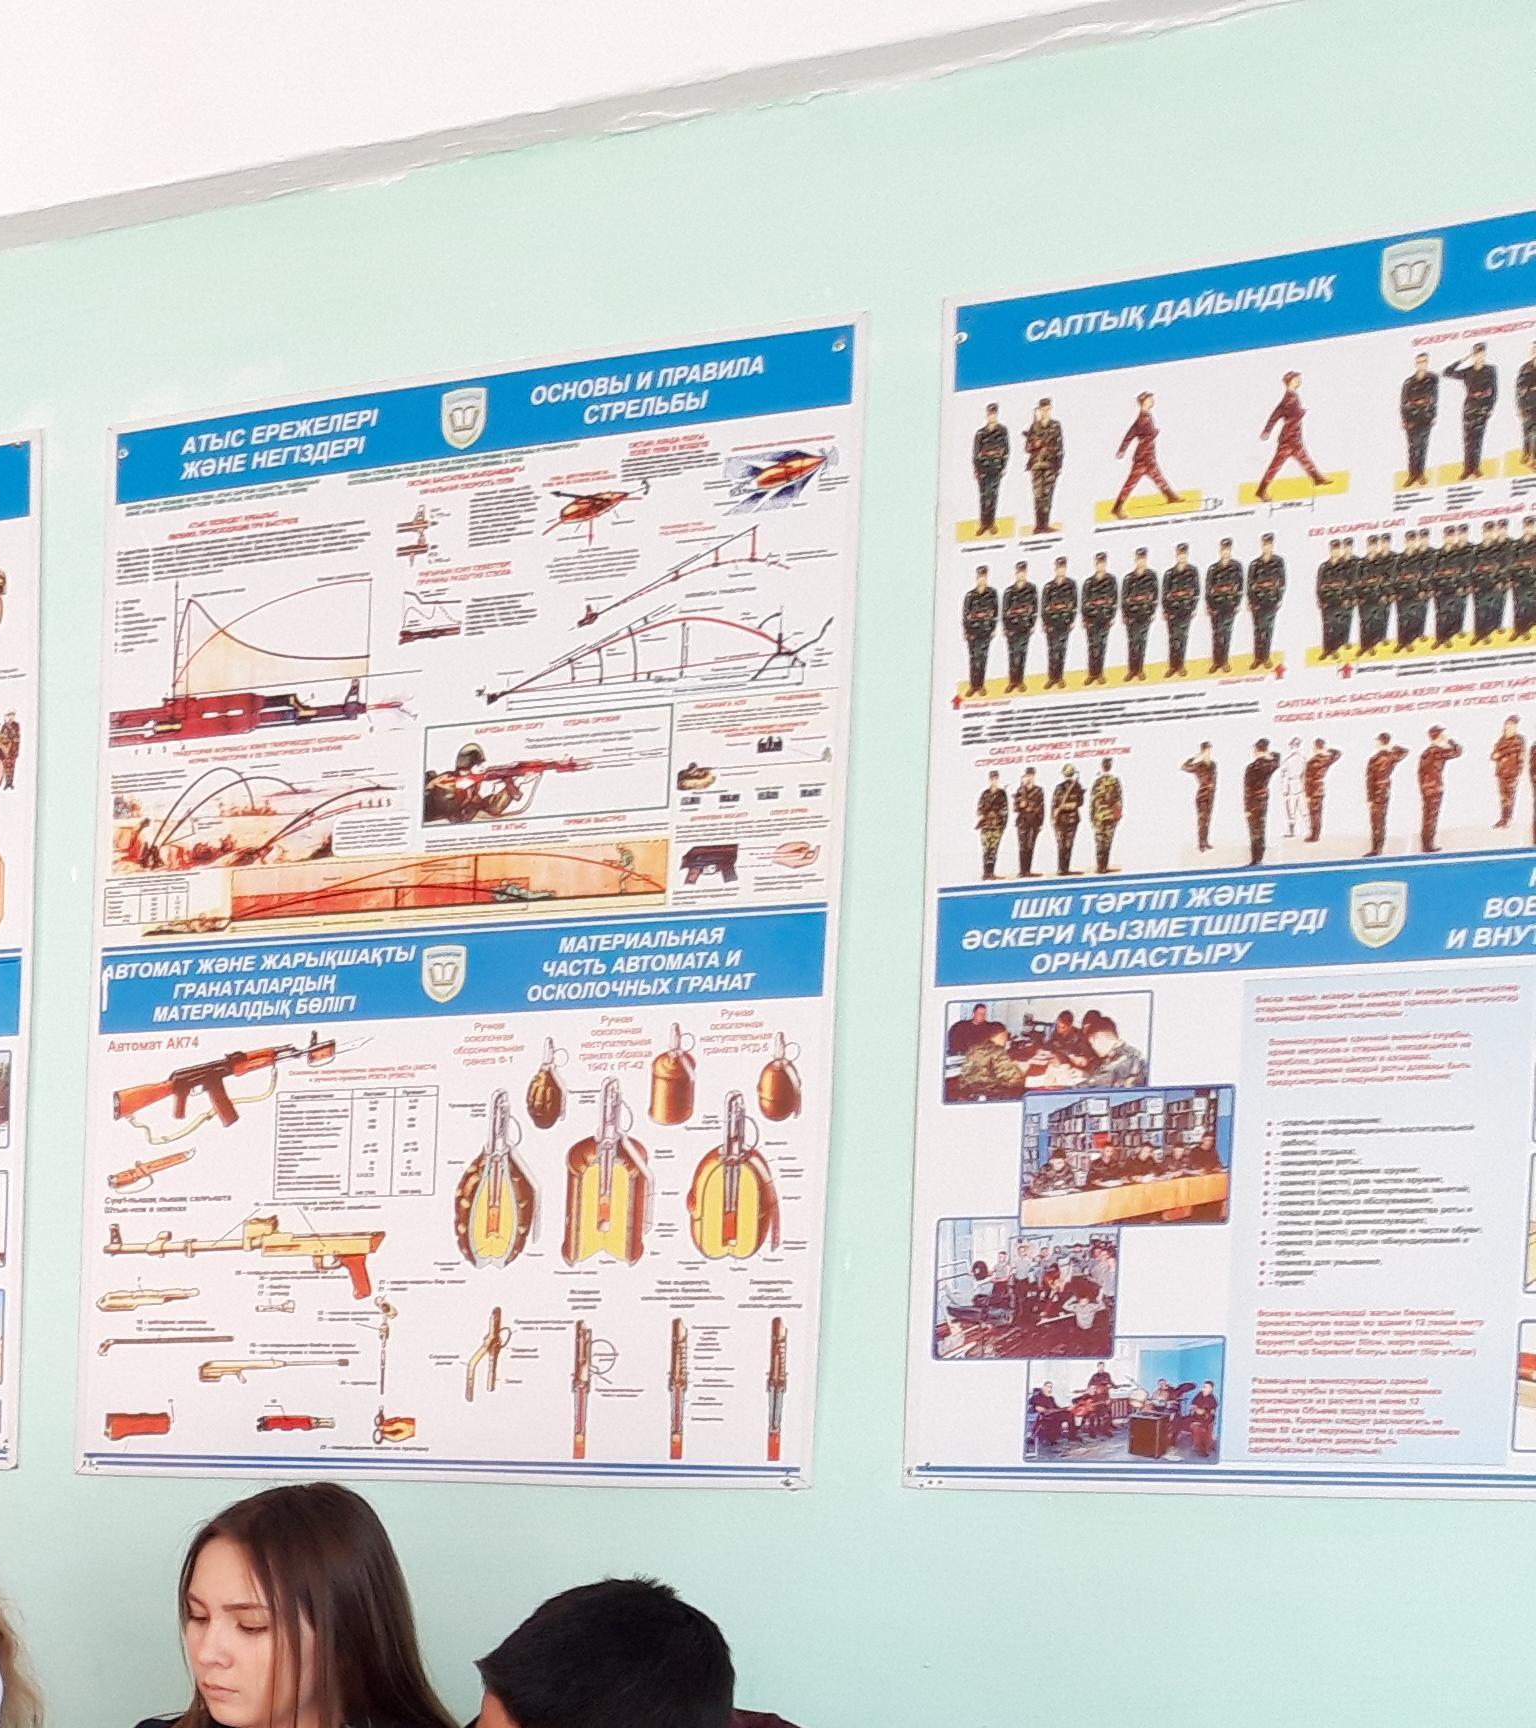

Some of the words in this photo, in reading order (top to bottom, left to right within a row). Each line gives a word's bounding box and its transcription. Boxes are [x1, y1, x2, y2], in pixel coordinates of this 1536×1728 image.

[1026, 302, 1149, 342] САПТЫҚ
[1150, 274, 1339, 329] ДАЙЫНДЫҚ
[531, 374, 631, 405] ОСНОВЫ
[636, 371, 653, 391] И
[657, 355, 764, 389] ПРАВИЛА
[584, 390, 709, 424] СТРЕЛЬБЫ
[181, 429, 246, 455] АТЫС
[250, 409, 379, 445] ЕРЕЖЕЛЕРІ
[180, 453, 247, 480] ЖӘНЕ
[252, 436, 365, 469] НЕГІЗДЕРІ
[1011, 898, 1071, 920] ІШКІ
[1081, 890, 1180, 914] ТӘРТІП
[1185, 882, 1276, 909] ЖӘНЕ
[559, 927, 726, 953] МАТЕРИАЛЬНАЯ
[961, 924, 1076, 950] ӘСКЕРИ
[1081, 908, 1328, 948] ҚЫЗМЕТШІЛЕРДІ
[1446, 928, 1468, 950] И
[103, 959, 193, 980] АВТОМАТ
[196, 955, 255, 974] ЖӘНЕ
[261, 945, 416, 970] ЖАРЫҚШАҚТЫ
[543, 958, 606, 977] ЧАСТЬ
[611, 952, 720, 974] АВТОМАТА
[726, 950, 742, 966] И
[1030, 941, 1253, 975] ОРНАЛАСТЫРУ
[173, 975, 336, 1000] ГРАНАТАЛАРДЫҢ
[527, 977, 673, 1002] ОСКОЛОЧНЫХ
[676, 973, 756, 993] ГРАНАТ
[153, 1001, 292, 1022] МАТЕРИАЛДЫҚ
[296, 996, 357, 1014] БӨЛІГІ
[108, 1039, 161, 1052] Автомат
[166, 1036, 199, 1049] АК74
